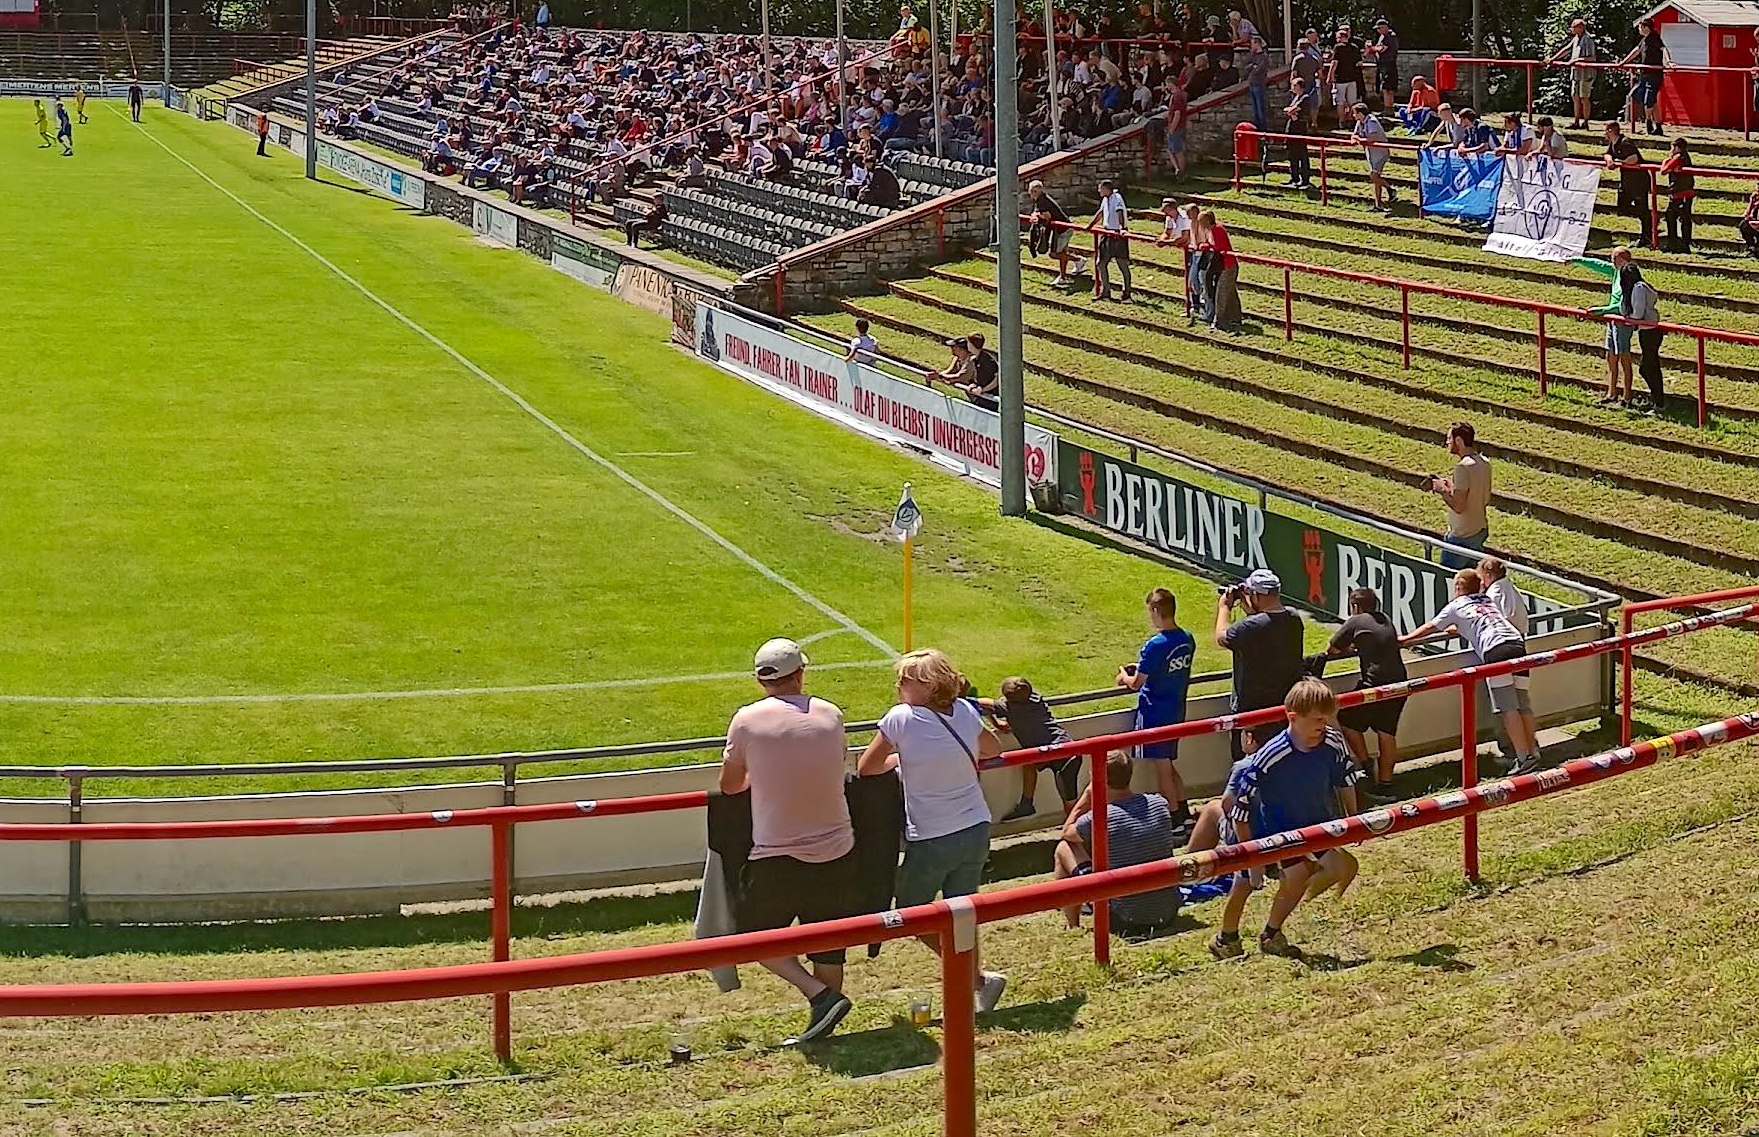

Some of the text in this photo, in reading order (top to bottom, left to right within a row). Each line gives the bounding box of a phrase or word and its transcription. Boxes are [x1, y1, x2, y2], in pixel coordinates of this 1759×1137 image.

[7, 81, 54, 90] MERTENS
[1561, 174, 1571, 189] G
[725, 333, 752, 369] FREUND,
[753, 344, 784, 382] FAHRER,
[784, 357, 802, 390] FAN,
[803, 364, 838, 403] TRAINER
[853, 385, 876, 420] OLAF
[877, 395, 891, 425] DU
[892, 400, 930, 442] BLEIBST
[932, 416, 1002, 470] UNVERGESSE
[1103, 461, 1269, 571] BERLINER
[1168, 654, 1191, 673] SSC
